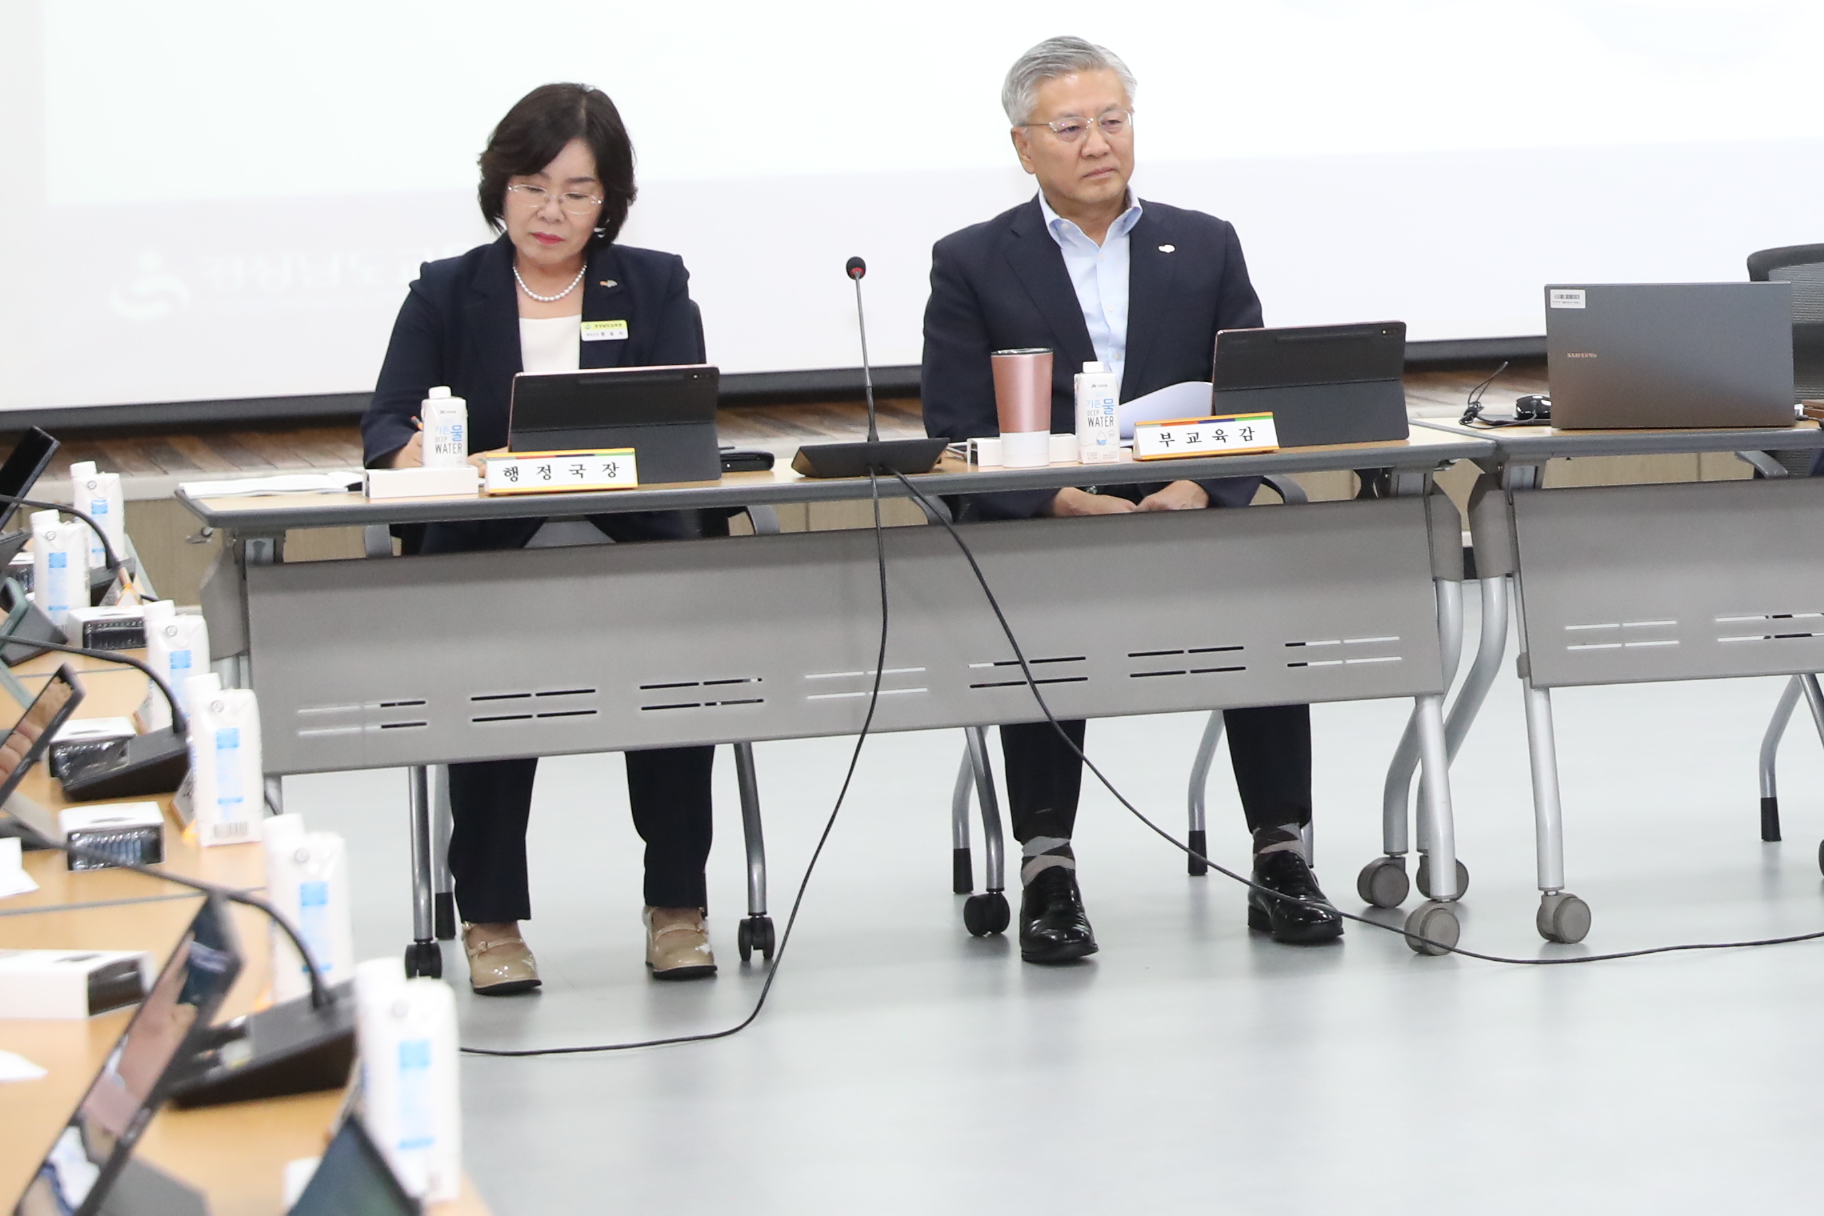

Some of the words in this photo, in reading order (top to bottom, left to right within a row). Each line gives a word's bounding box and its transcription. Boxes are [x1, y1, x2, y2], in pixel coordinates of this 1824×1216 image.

[1101, 398, 1115, 415] 물
[1087, 416, 1115, 428] WATER
[450, 424, 463, 442] 물
[1158, 426, 1256, 447] 부교육감
[435, 442, 463, 455] WATER
[502, 461, 620, 483] 행정국장
